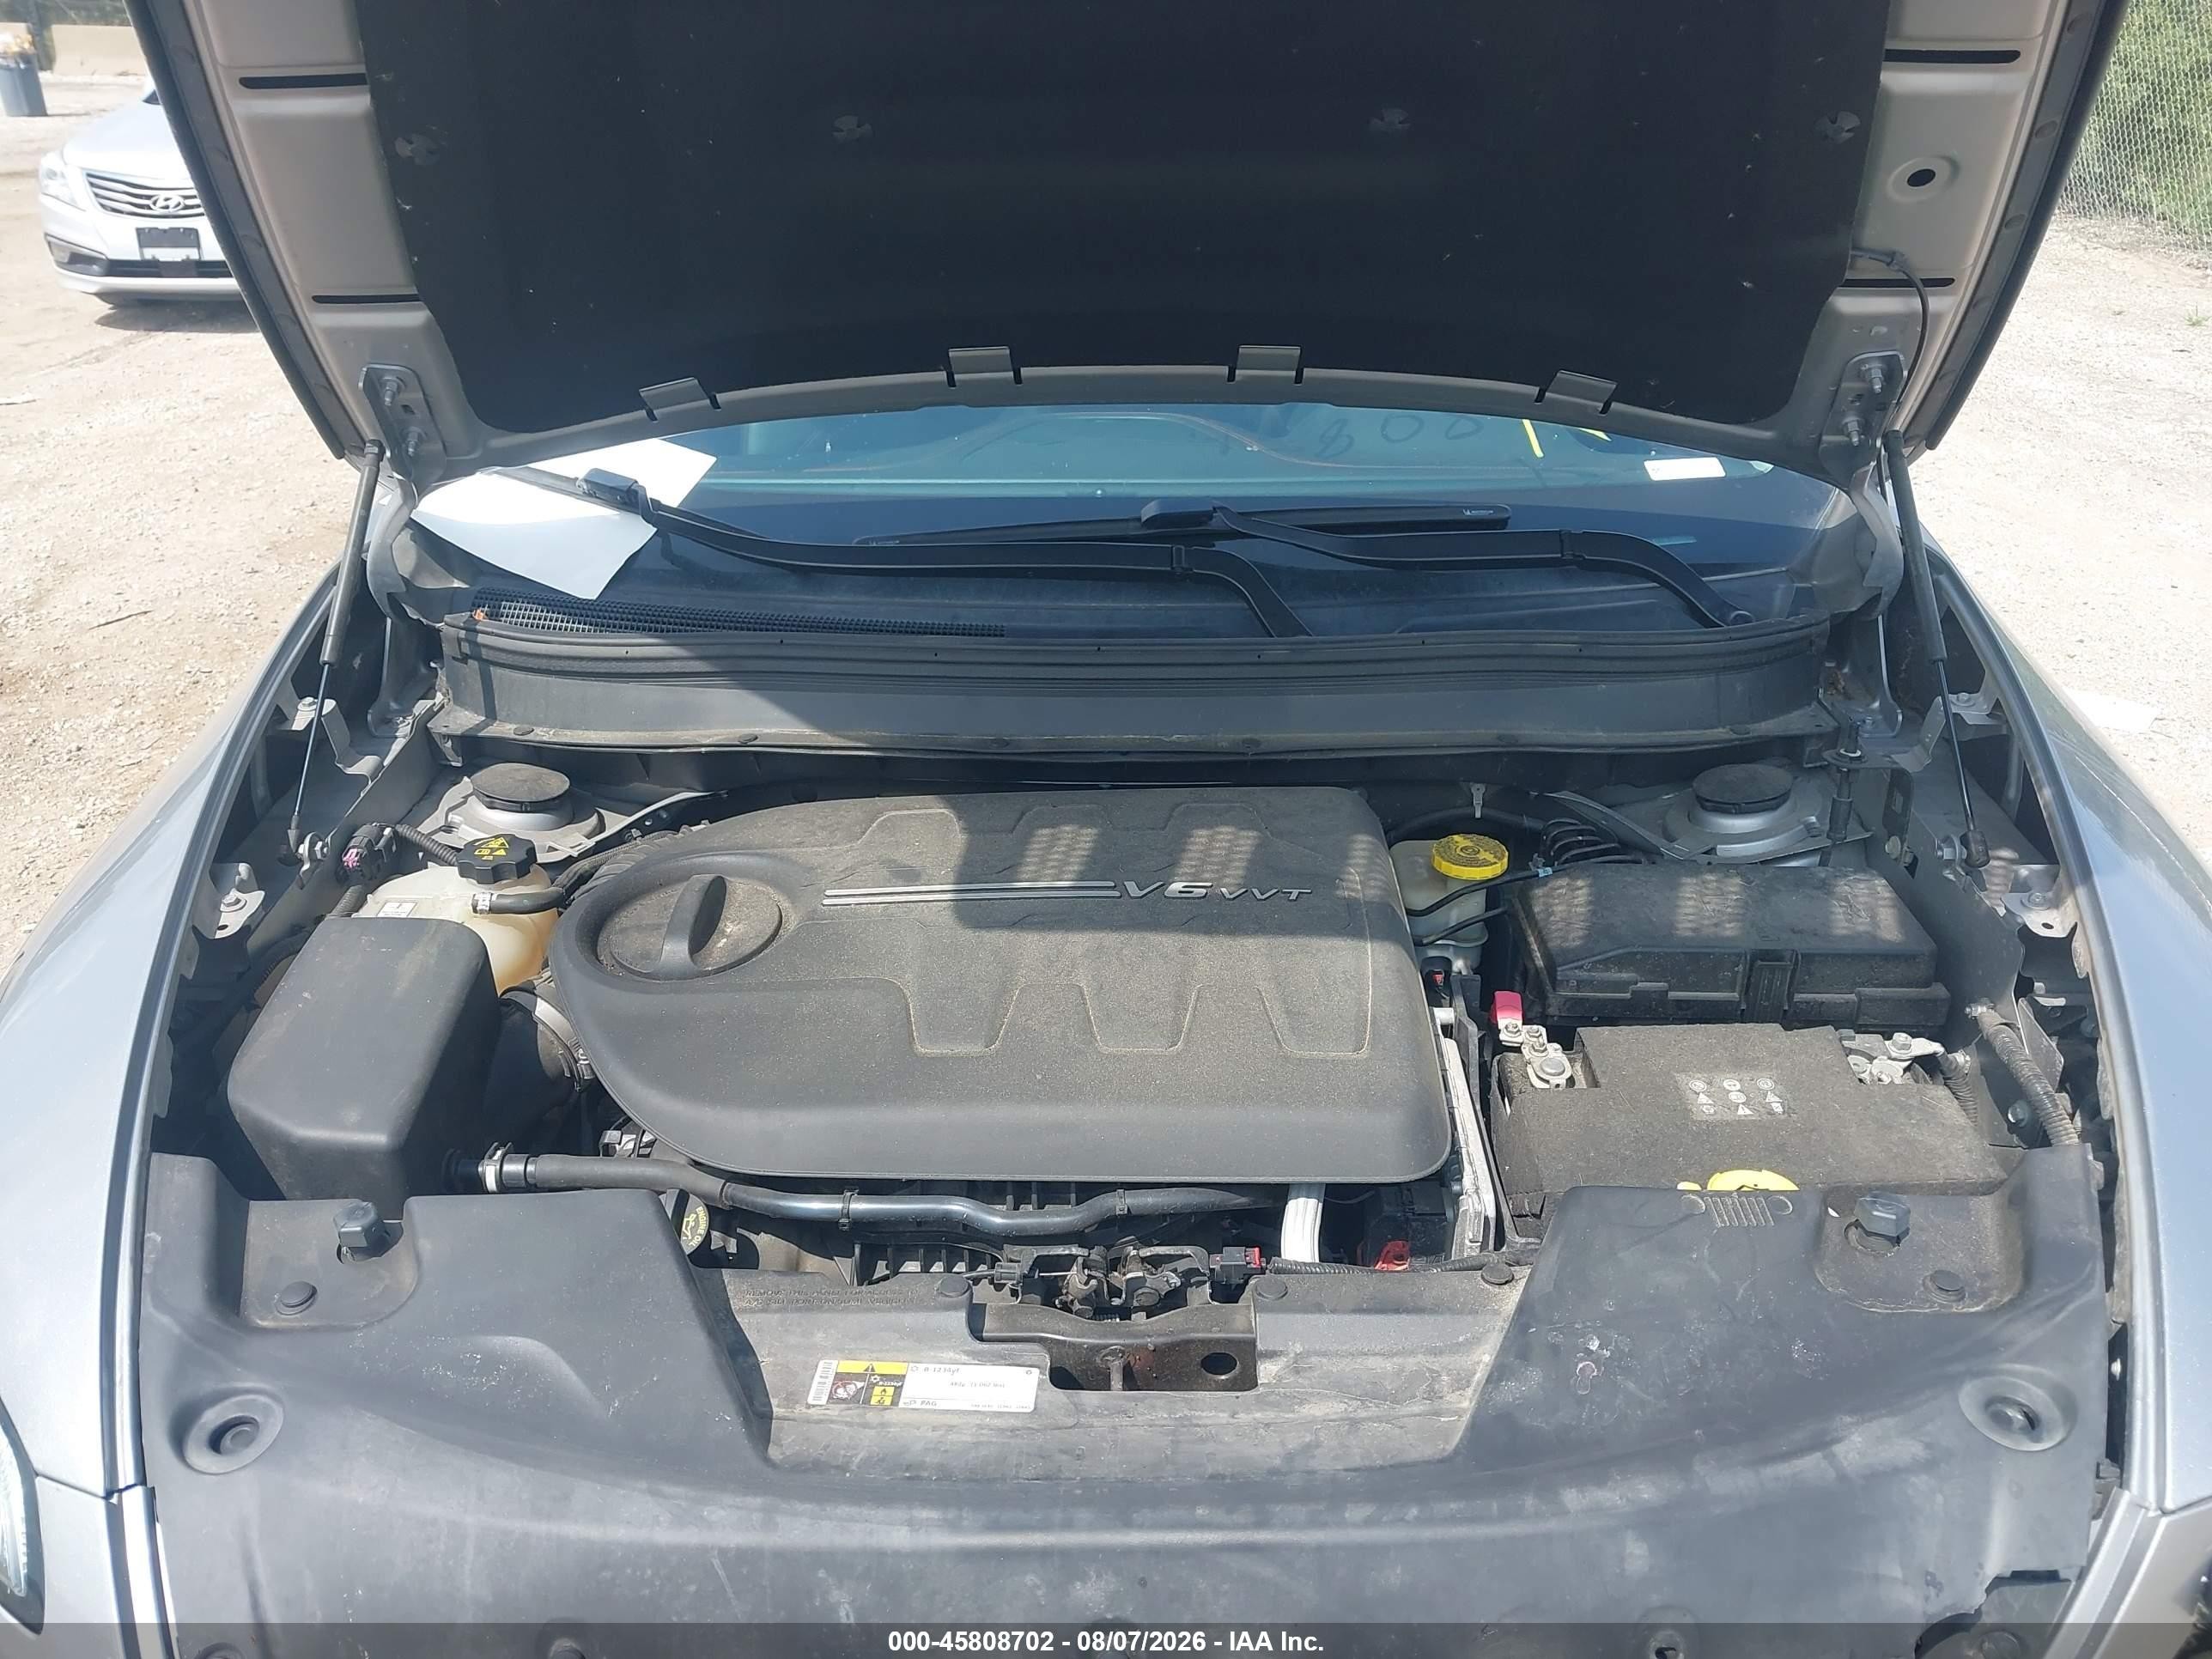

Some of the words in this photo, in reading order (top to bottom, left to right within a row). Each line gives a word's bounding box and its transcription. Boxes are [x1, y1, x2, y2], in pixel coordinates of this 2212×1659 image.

[1123, 881, 1213, 898] V6
[1220, 887, 1312, 901] VVT
[696, 1206, 707, 1235] ENGINE
[688, 1235, 702, 1247] OIL
